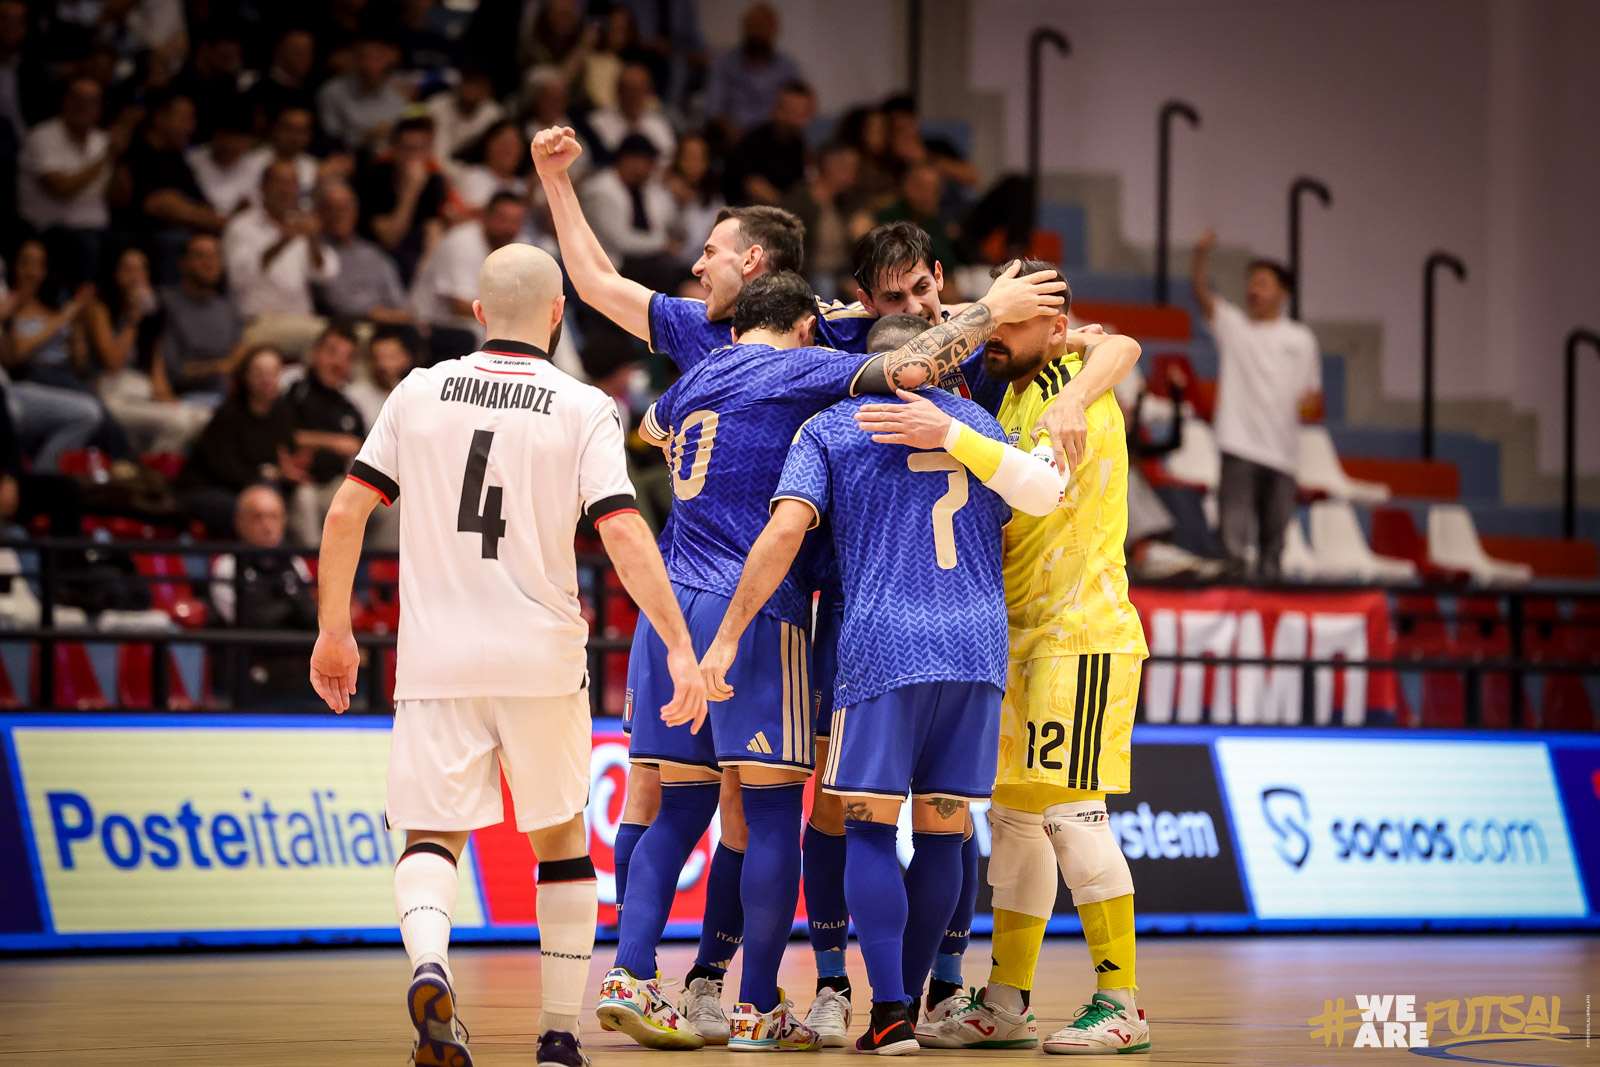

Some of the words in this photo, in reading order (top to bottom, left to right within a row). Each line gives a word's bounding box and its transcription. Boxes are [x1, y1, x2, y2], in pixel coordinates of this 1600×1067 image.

[440, 377, 557, 415] CHIMAKADZE
[942, 376, 963, 388] ITALIA
[457, 429, 507, 561] 4
[907, 451, 969, 570] 7
[1027, 721, 1065, 770] 12
[812, 919, 846, 930] ITALIA
